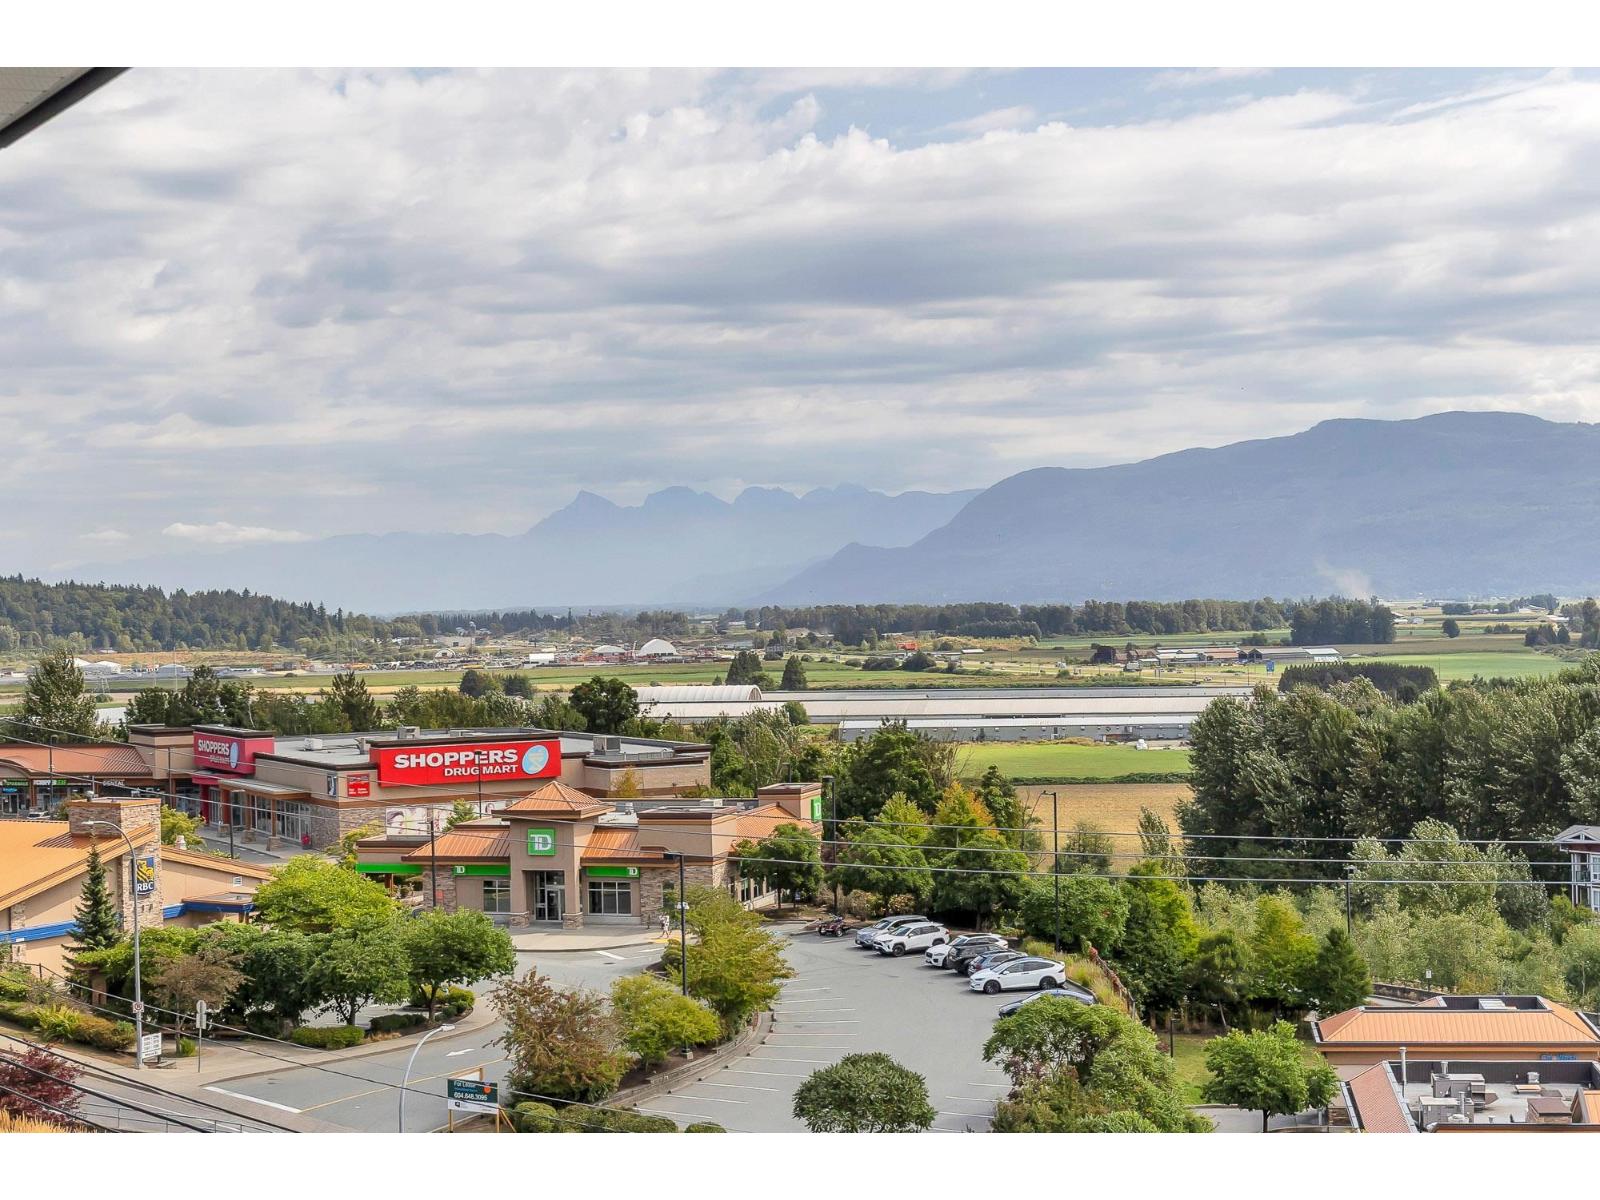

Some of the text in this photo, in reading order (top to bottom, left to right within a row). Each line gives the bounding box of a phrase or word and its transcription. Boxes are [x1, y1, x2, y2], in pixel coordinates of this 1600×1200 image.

[198, 740, 229, 755] SHOPPERS
[394, 750, 518, 768] SHOPPERS
[444, 764, 518, 776] DRUG MART
[530, 834, 552, 851] TD
[454, 866, 465, 874] TD
[627, 867, 638, 875] TD
[137, 882, 154, 891] RBC
